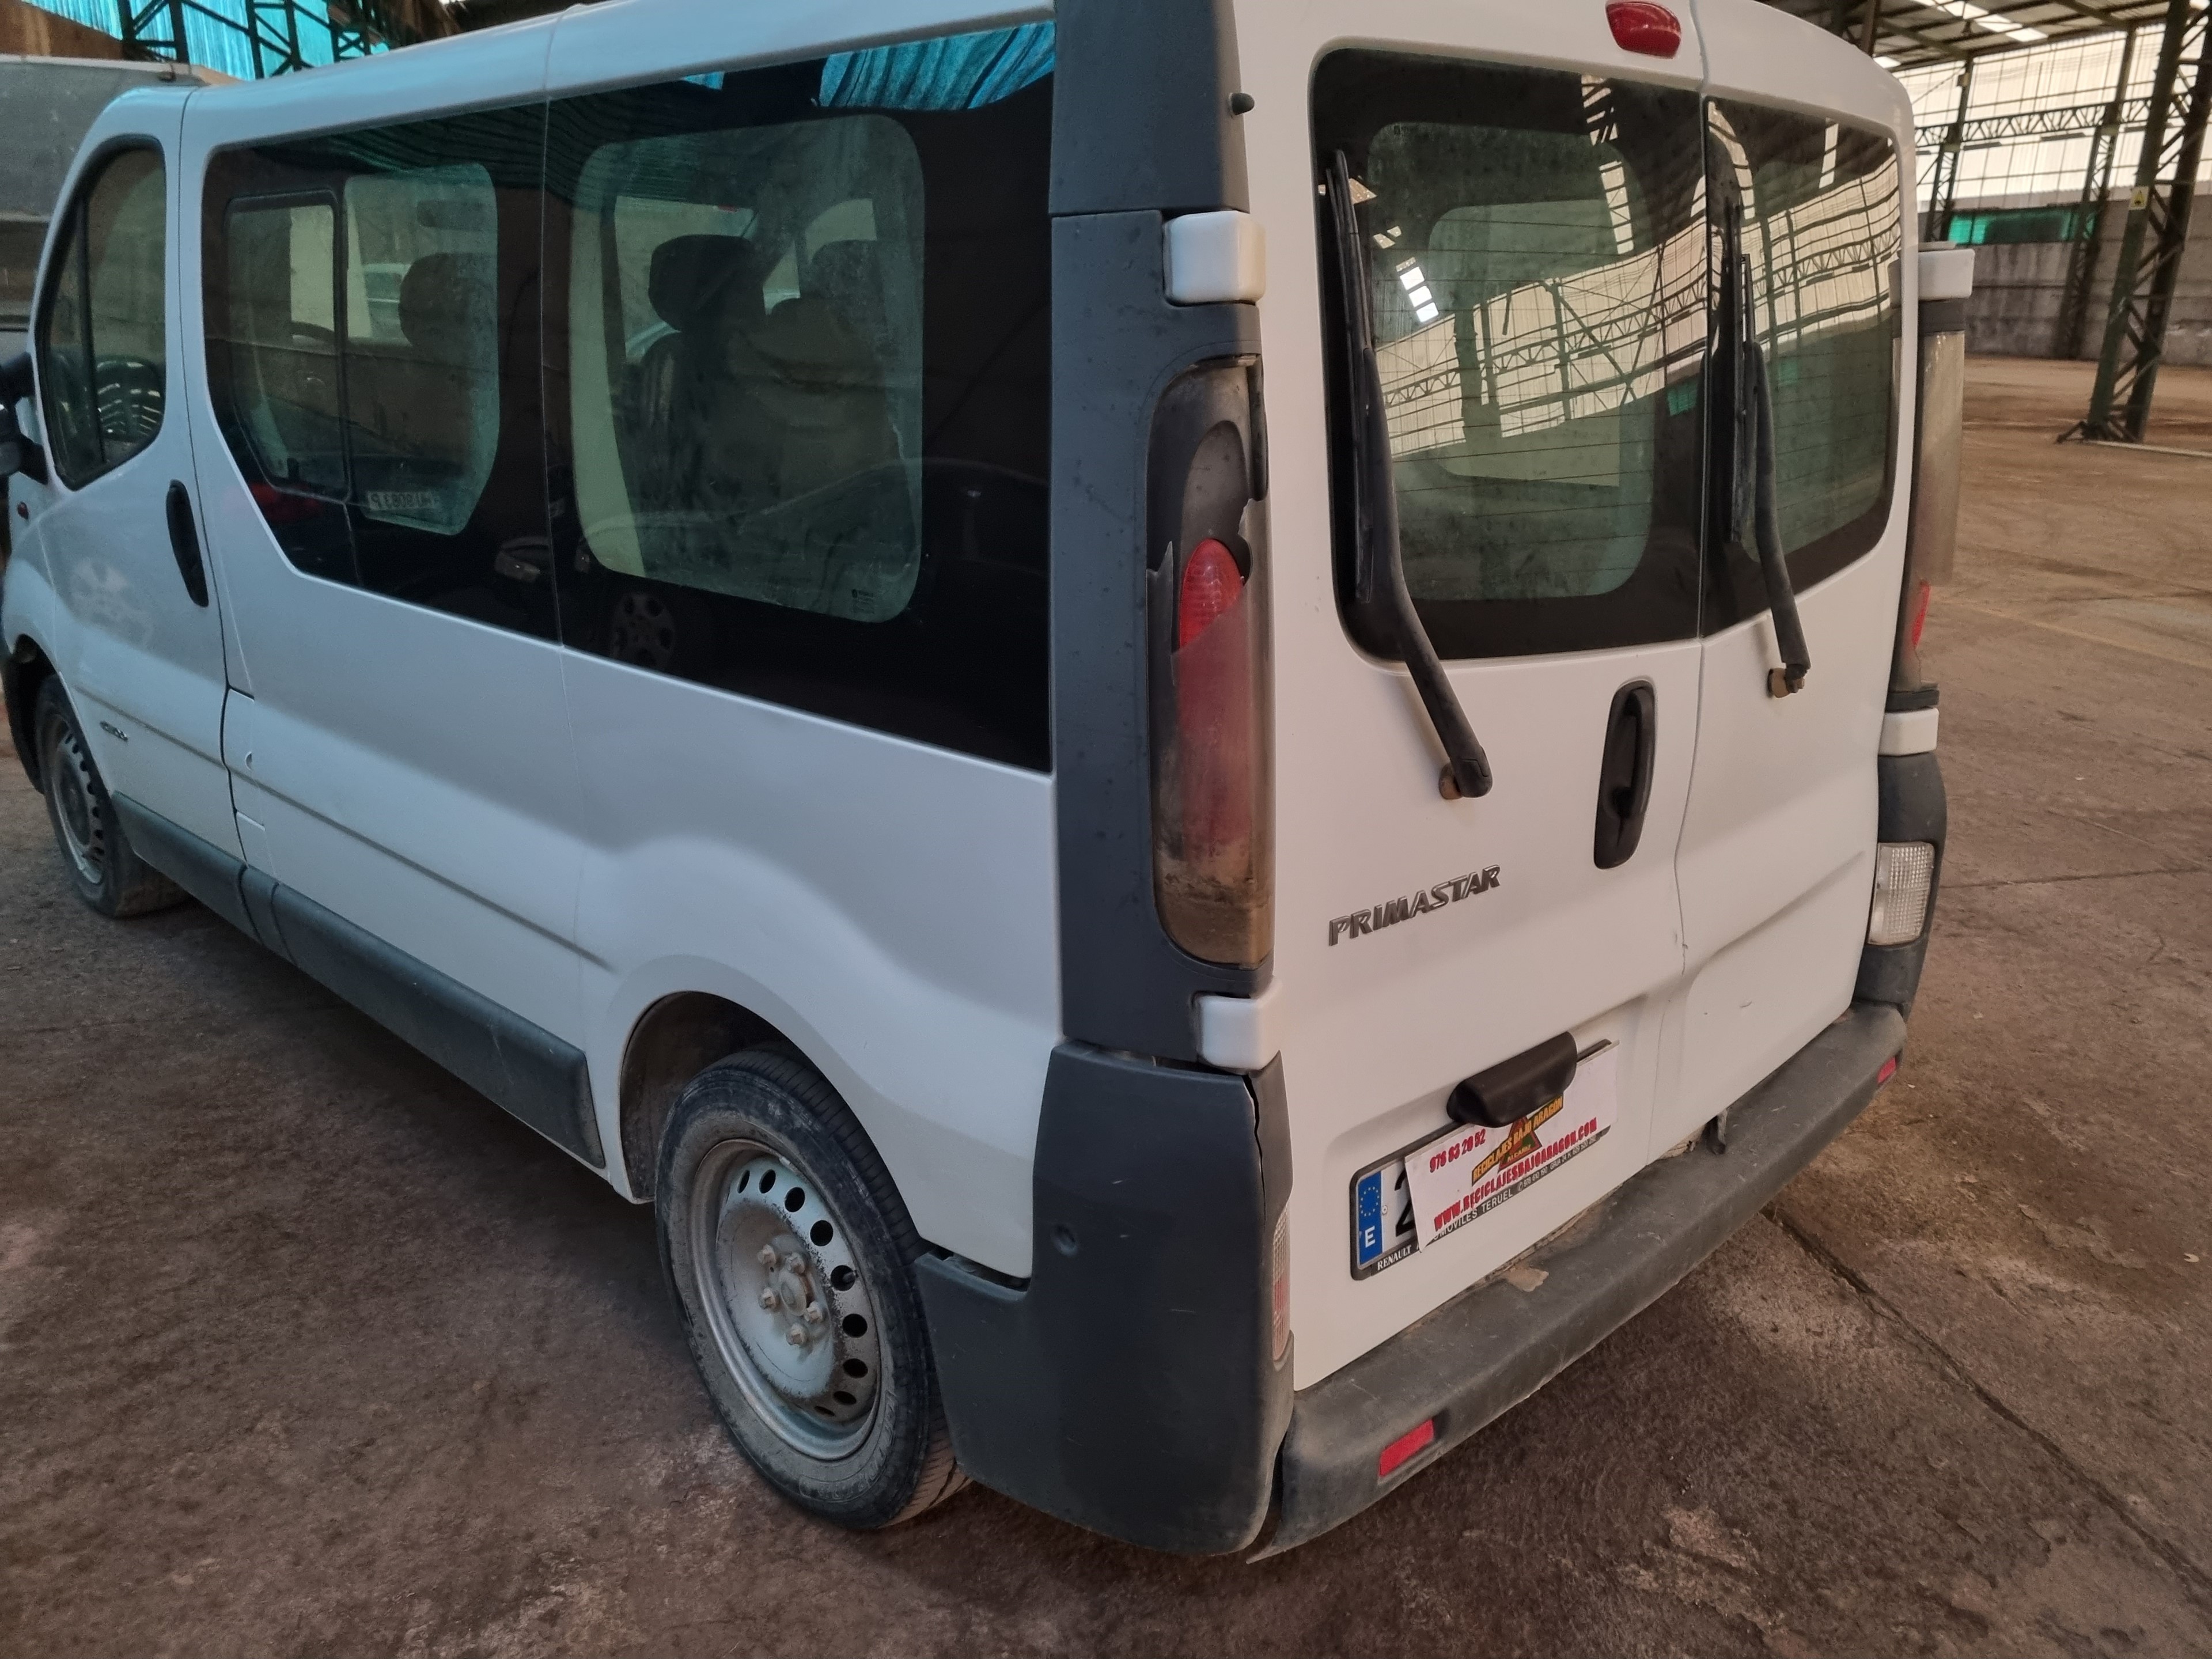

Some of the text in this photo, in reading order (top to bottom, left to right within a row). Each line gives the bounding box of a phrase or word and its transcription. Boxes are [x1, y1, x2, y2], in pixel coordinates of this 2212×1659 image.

[1328, 865, 1501, 946] PRIMASTAR
[1430, 1150, 1446, 1173] 978
[1448, 1143, 1460, 1163] 83
[1461, 1135, 1474, 1155] 20
[1365, 1225, 1376, 1248] E
[1377, 1244, 1412, 1271] RENAULT
[1482, 1188, 1513, 1212] TERUEL
